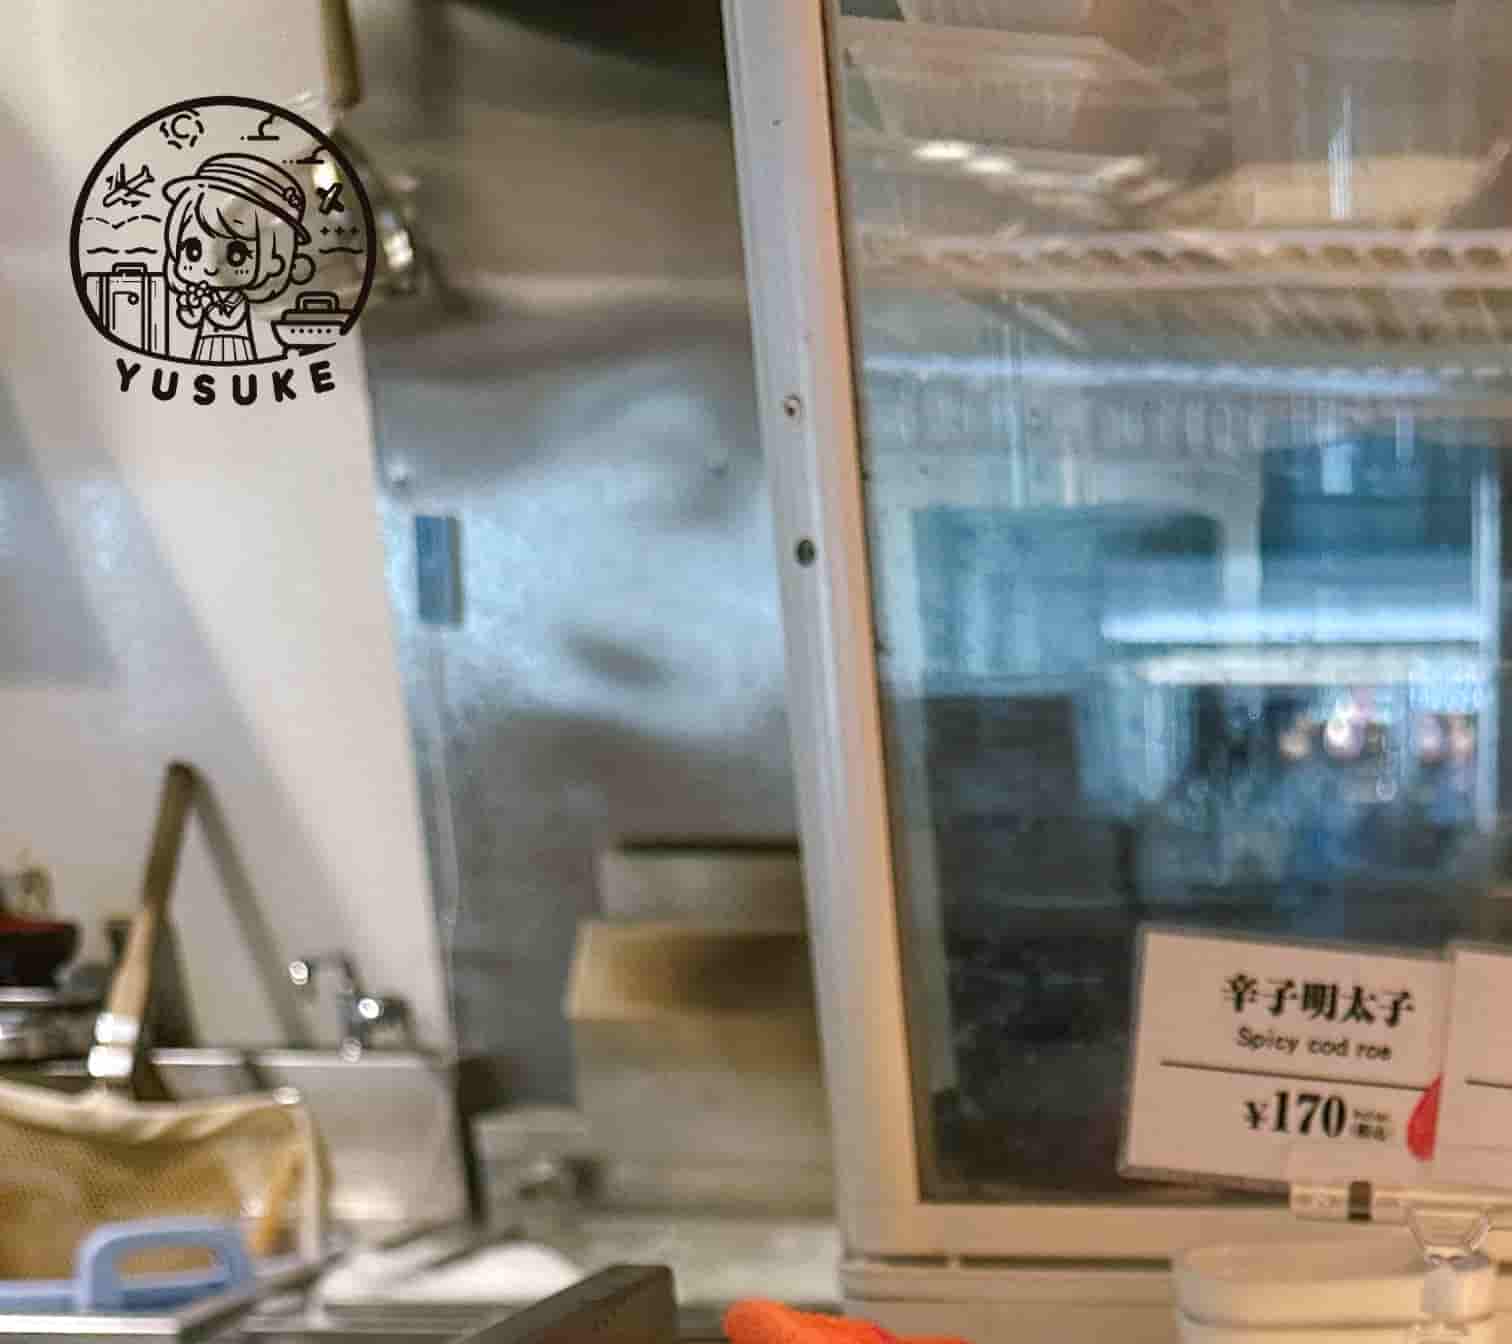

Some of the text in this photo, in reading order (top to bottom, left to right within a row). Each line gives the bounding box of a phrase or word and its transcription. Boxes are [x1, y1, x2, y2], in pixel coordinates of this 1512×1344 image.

[1221, 973, 1415, 1028] 辛子明太子
[1236, 1025, 1393, 1061] Spicy cod roe
[1242, 1090, 1347, 1138] ¥170
